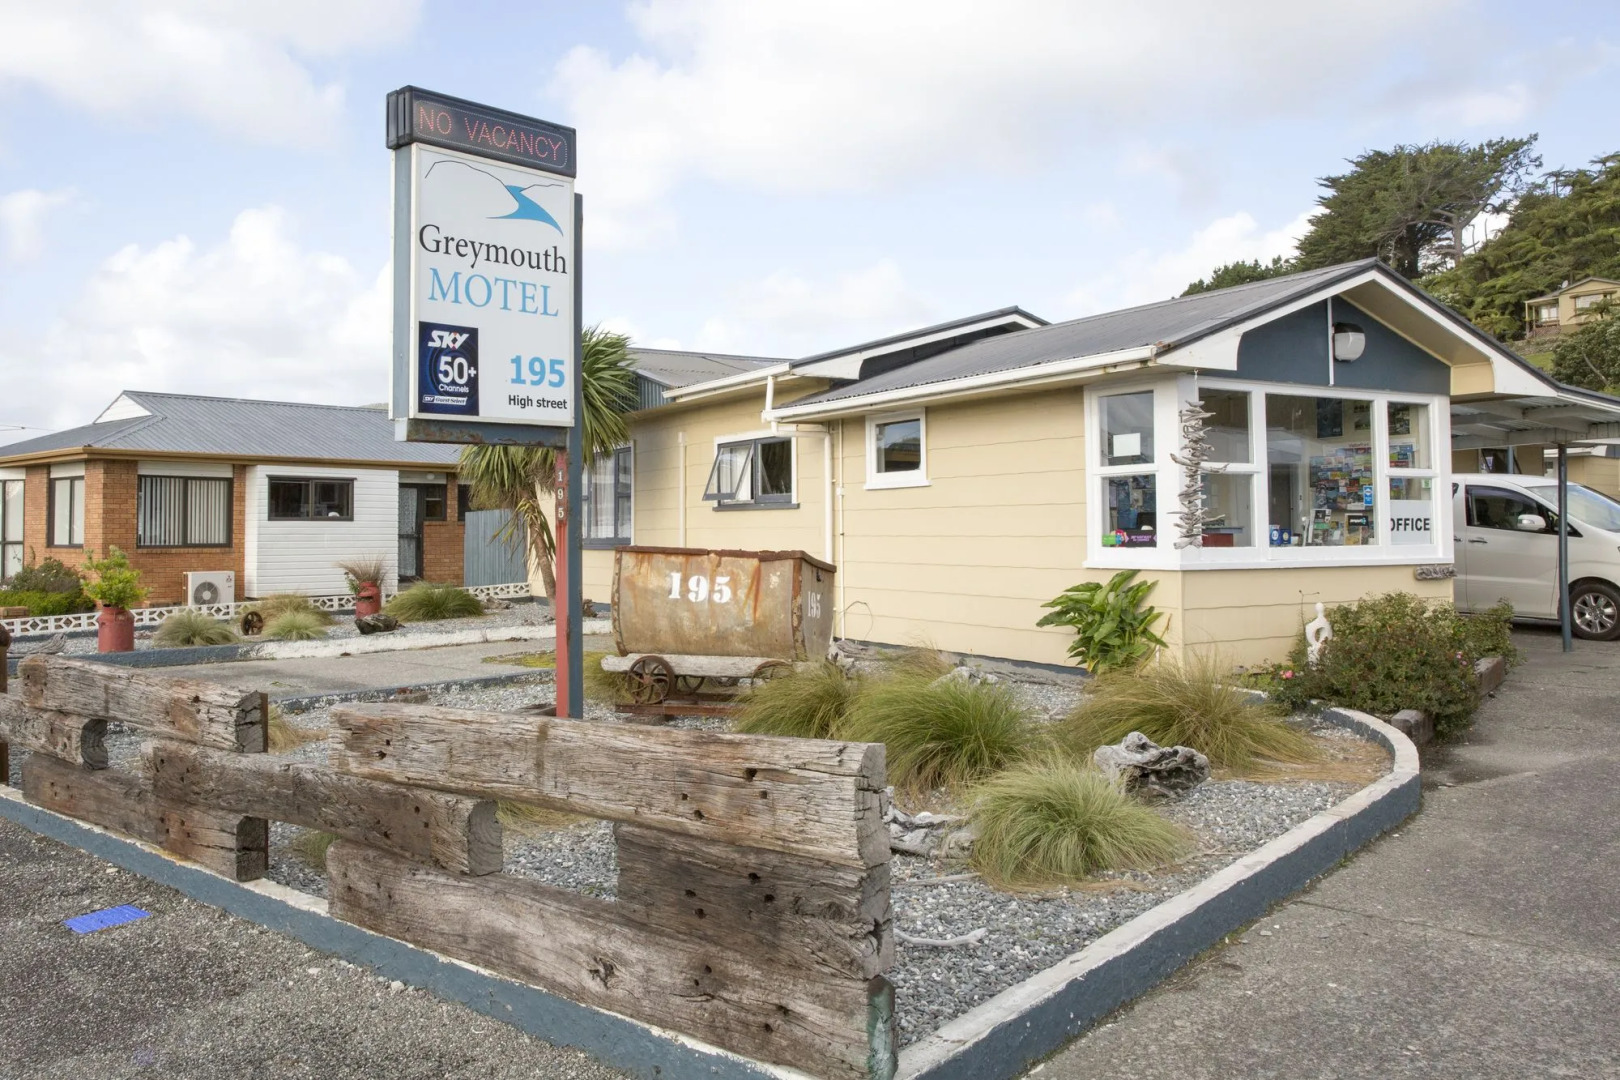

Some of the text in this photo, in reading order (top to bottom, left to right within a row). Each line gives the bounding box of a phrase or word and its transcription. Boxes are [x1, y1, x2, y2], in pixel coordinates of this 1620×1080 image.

[419, 106, 562, 161] NO VACANCY
[419, 224, 568, 275] Greymouth
[427, 267, 559, 318] MOTEL
[427, 329, 470, 350] SKY
[438, 355, 477, 385] 50+
[510, 354, 566, 388] 195
[438, 383, 470, 393] Channels
[508, 394, 568, 410] High street
[1390, 517, 1431, 531] OFFICE
[668, 571, 732, 604] 195
[807, 591, 822, 619] 195
